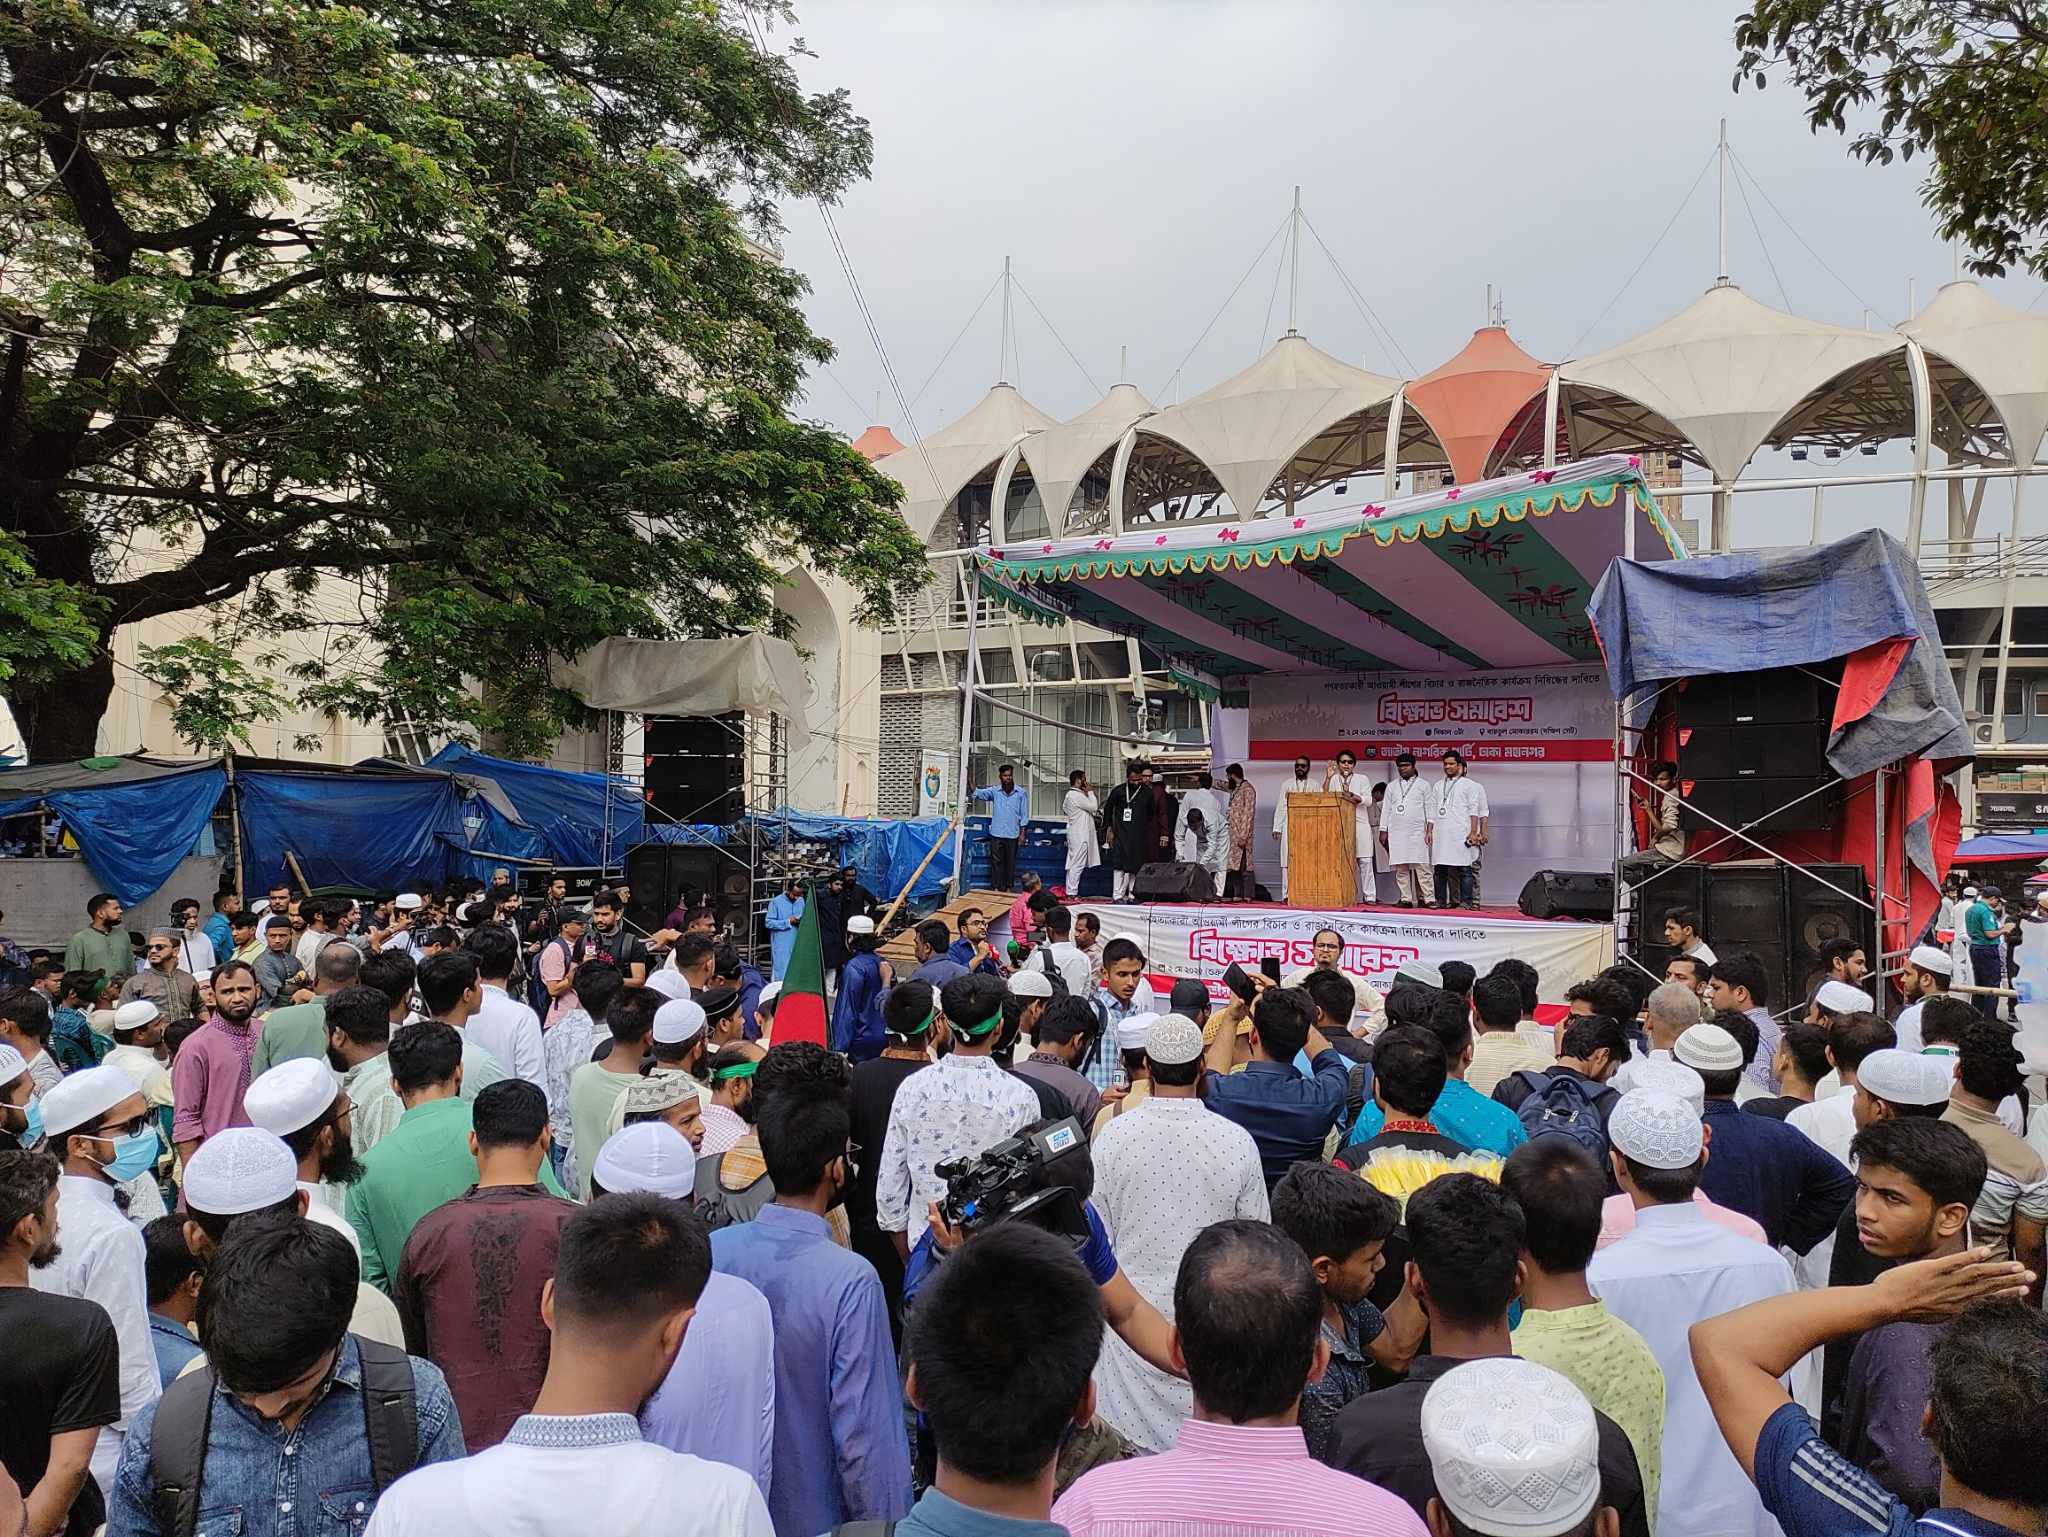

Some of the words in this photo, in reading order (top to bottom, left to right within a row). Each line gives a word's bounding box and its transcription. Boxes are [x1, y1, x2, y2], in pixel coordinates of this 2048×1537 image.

[1377, 692, 1446, 726] বিক্ষোভ
[1447, 697, 1533, 726] সমাবেশ
[1263, 918, 1287, 930] বিচার
[1449, 928, 1487, 942] দাবিতে
[1189, 928, 1290, 966] বিক্ষোভ
[1291, 941, 1419, 976] সাবেশ
